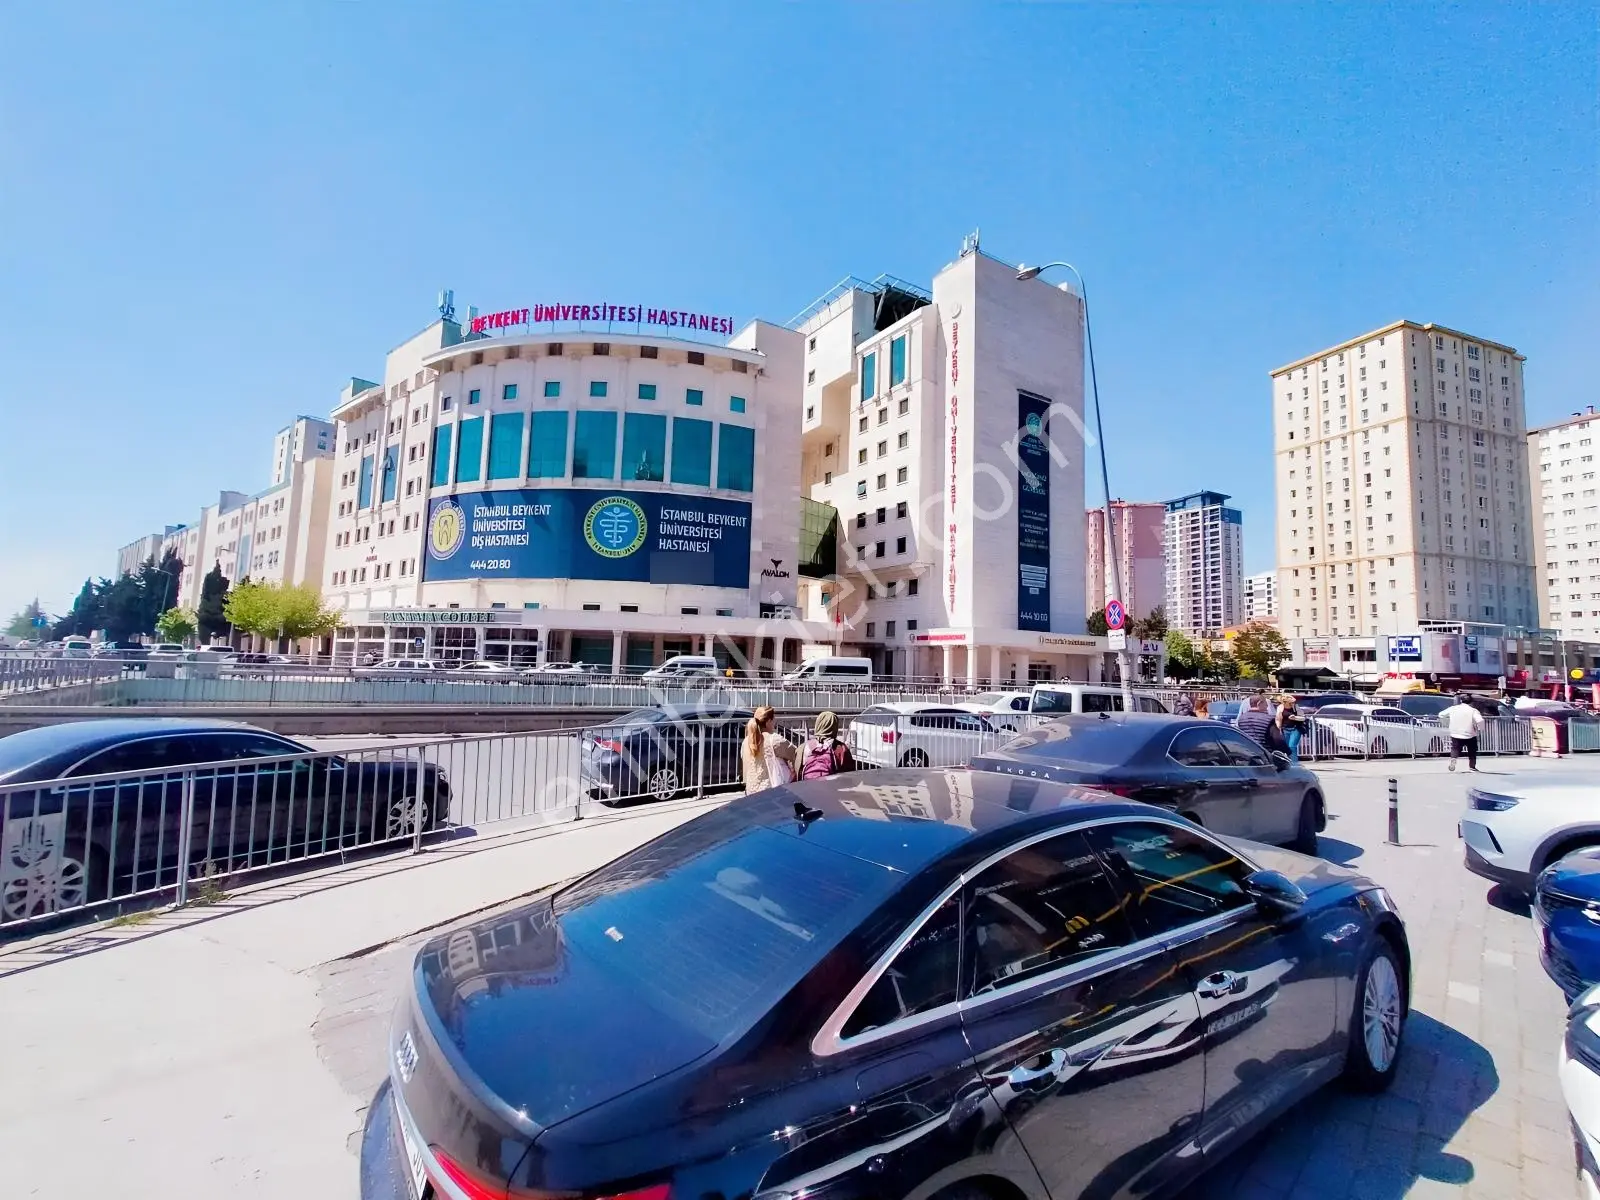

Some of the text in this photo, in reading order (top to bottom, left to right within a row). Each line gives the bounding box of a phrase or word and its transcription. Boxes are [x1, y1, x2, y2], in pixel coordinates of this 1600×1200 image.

[471, 302, 734, 336] BEYKENT ÜNİVERSİTESİ HASTANESİ
[474, 504, 511, 518] İSTANBUL
[512, 504, 551, 516] BEYKENT
[660, 505, 747, 527] İSTANBUL BEYKENT
[473, 518, 526, 533] ÜNİVERSİTESİ
[659, 524, 722, 539] ÜNİVERSİTESİ
[472, 532, 529, 549] DİŞ HASTANESİ
[659, 538, 710, 553] HASTANESİ
[470, 559, 511, 570] 444 20 80
